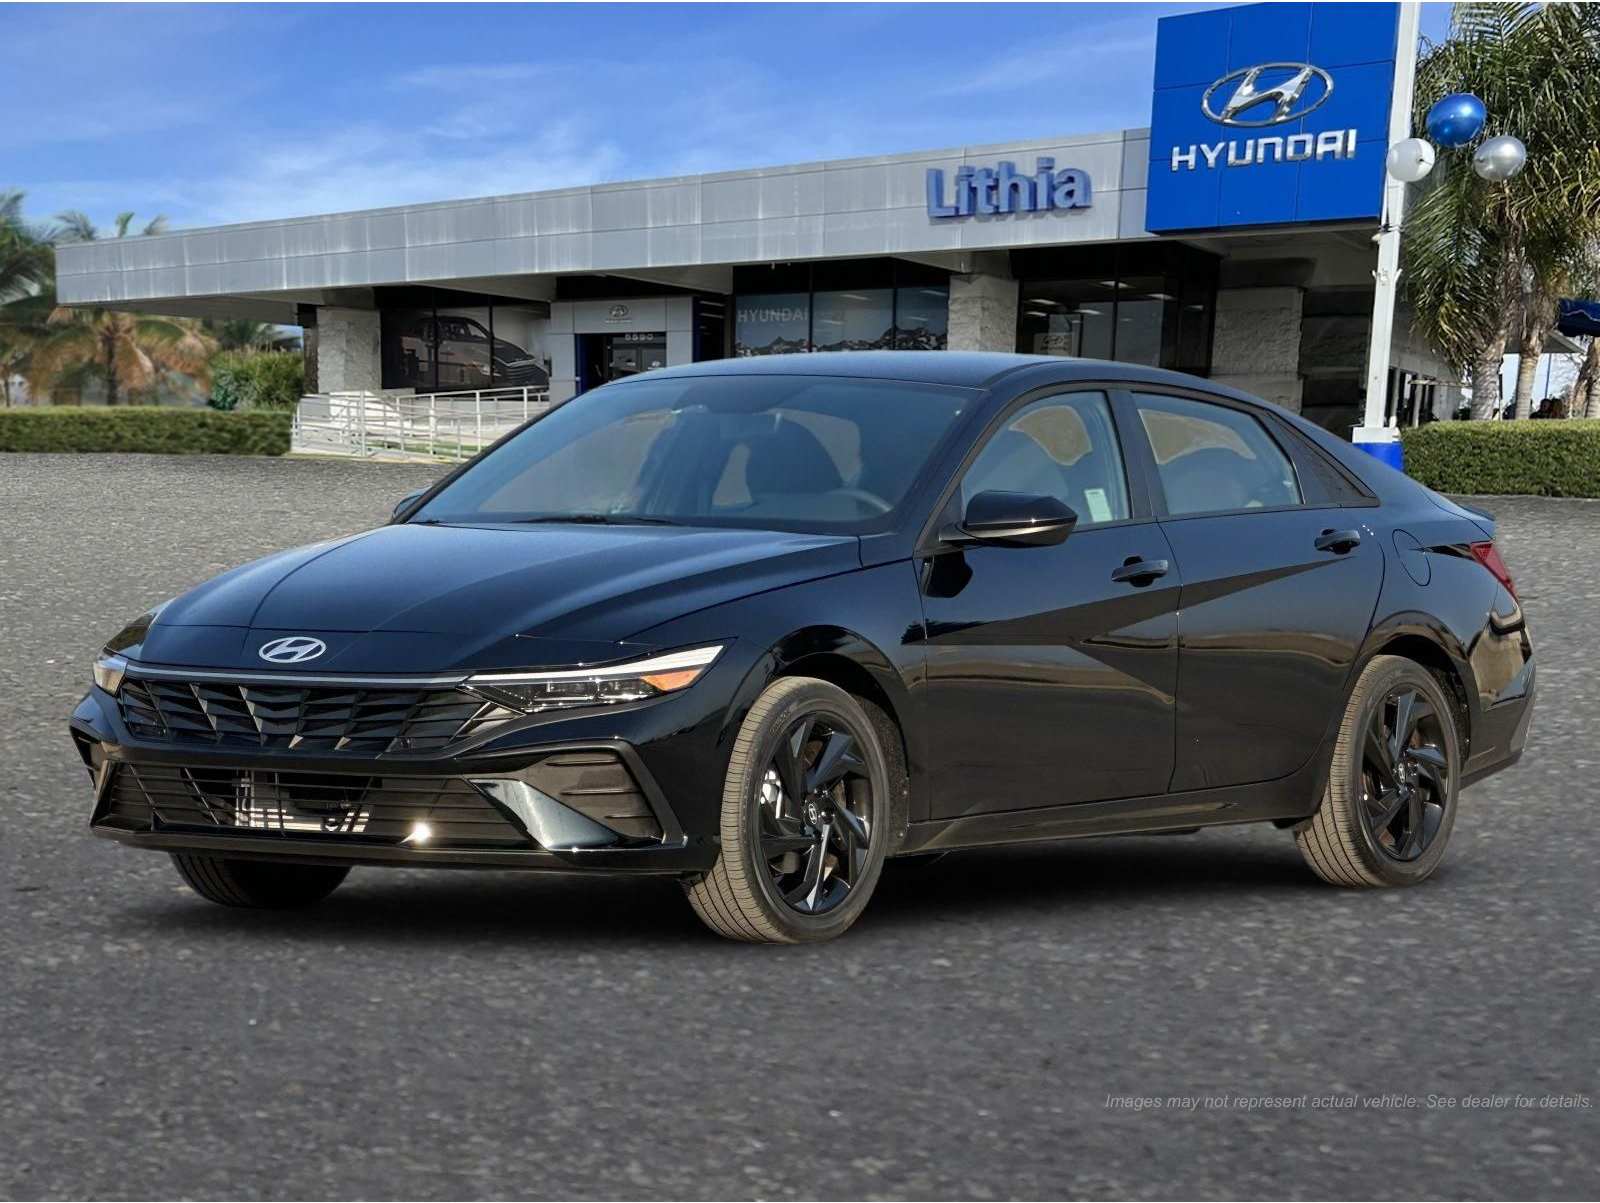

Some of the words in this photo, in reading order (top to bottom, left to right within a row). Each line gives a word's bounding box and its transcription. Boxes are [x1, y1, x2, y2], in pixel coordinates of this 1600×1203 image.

[1171, 128, 1358, 172] HYUNDAI
[926, 156, 1093, 219] Lithia
[737, 307, 809, 323] HYUNDAI
